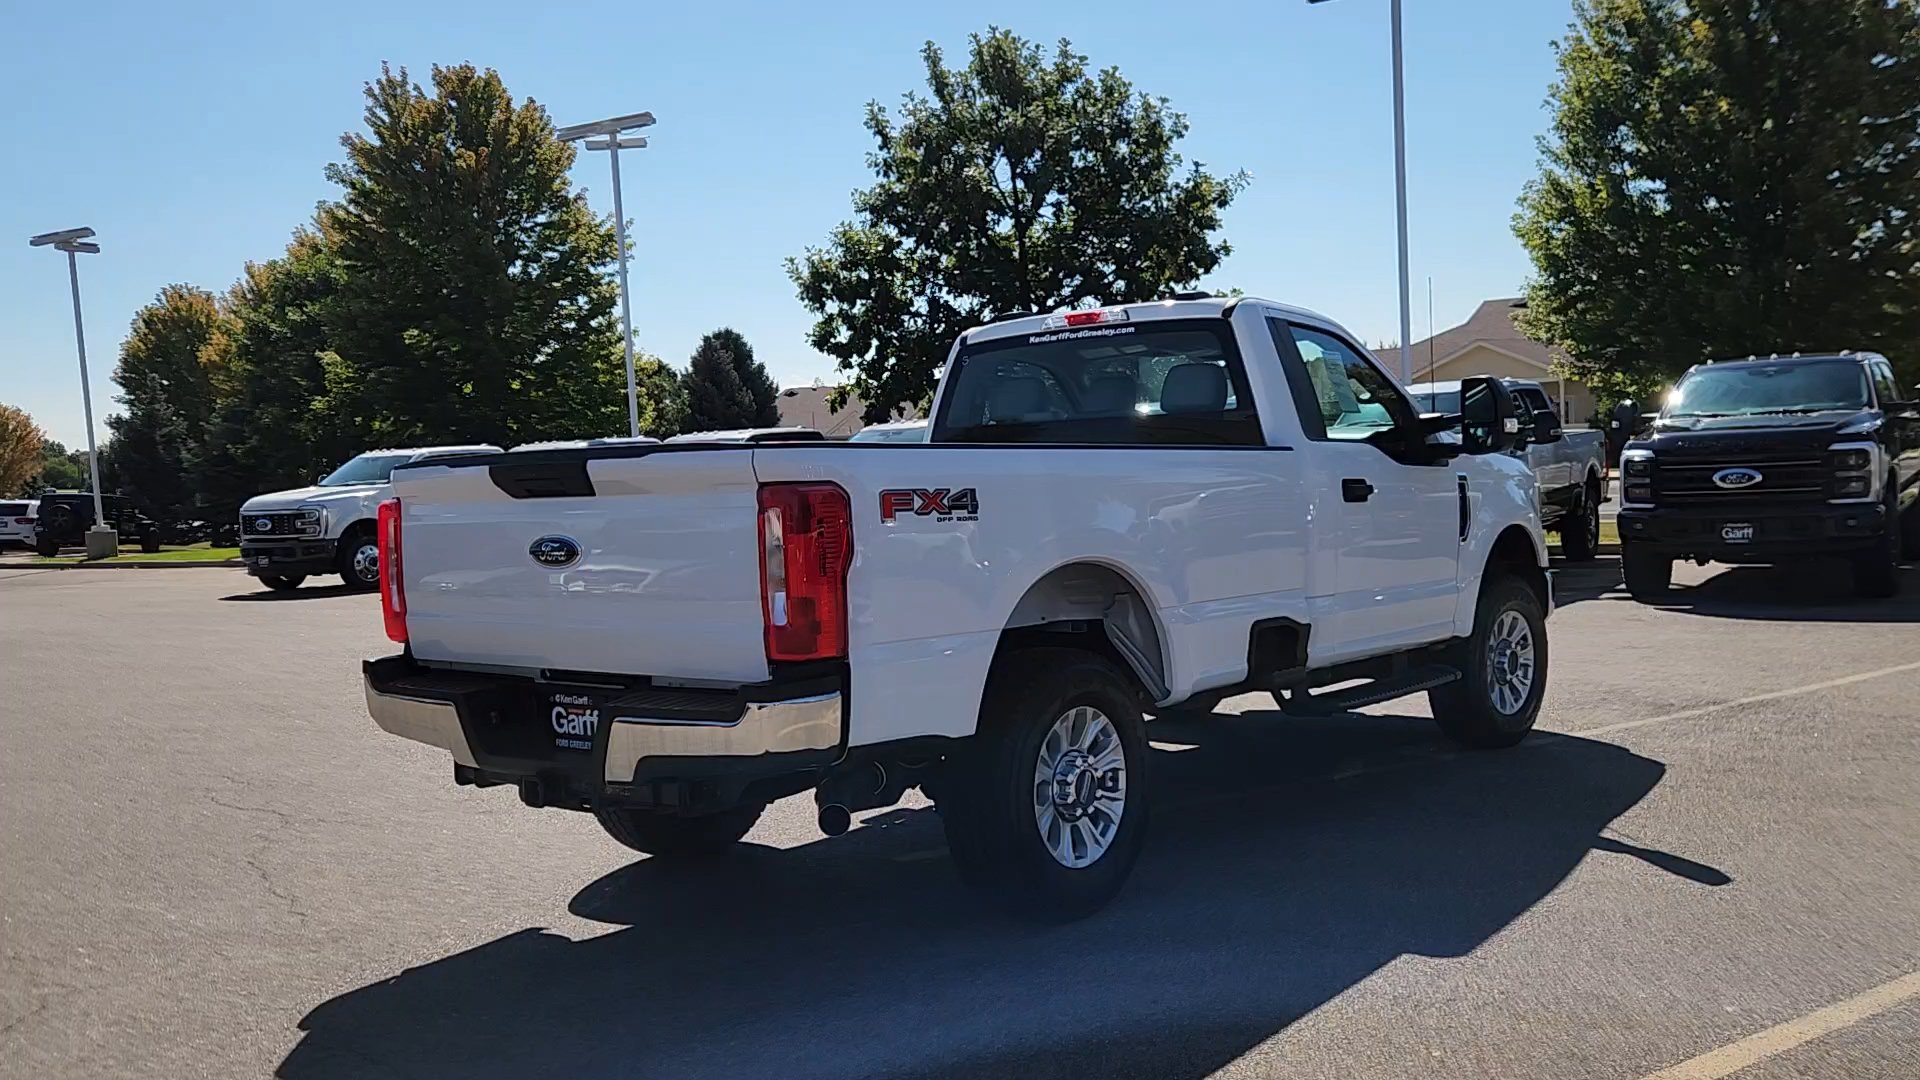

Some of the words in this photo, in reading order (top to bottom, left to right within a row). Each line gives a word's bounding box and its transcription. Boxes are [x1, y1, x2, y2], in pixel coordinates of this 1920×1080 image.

[1029, 327, 1135, 343] KenGarffFordGreeley.com
[879, 488, 979, 525] FX4
[1721, 527, 1753, 539] Garff
[539, 541, 567, 560] Ford
[551, 706, 599, 736] Garff
